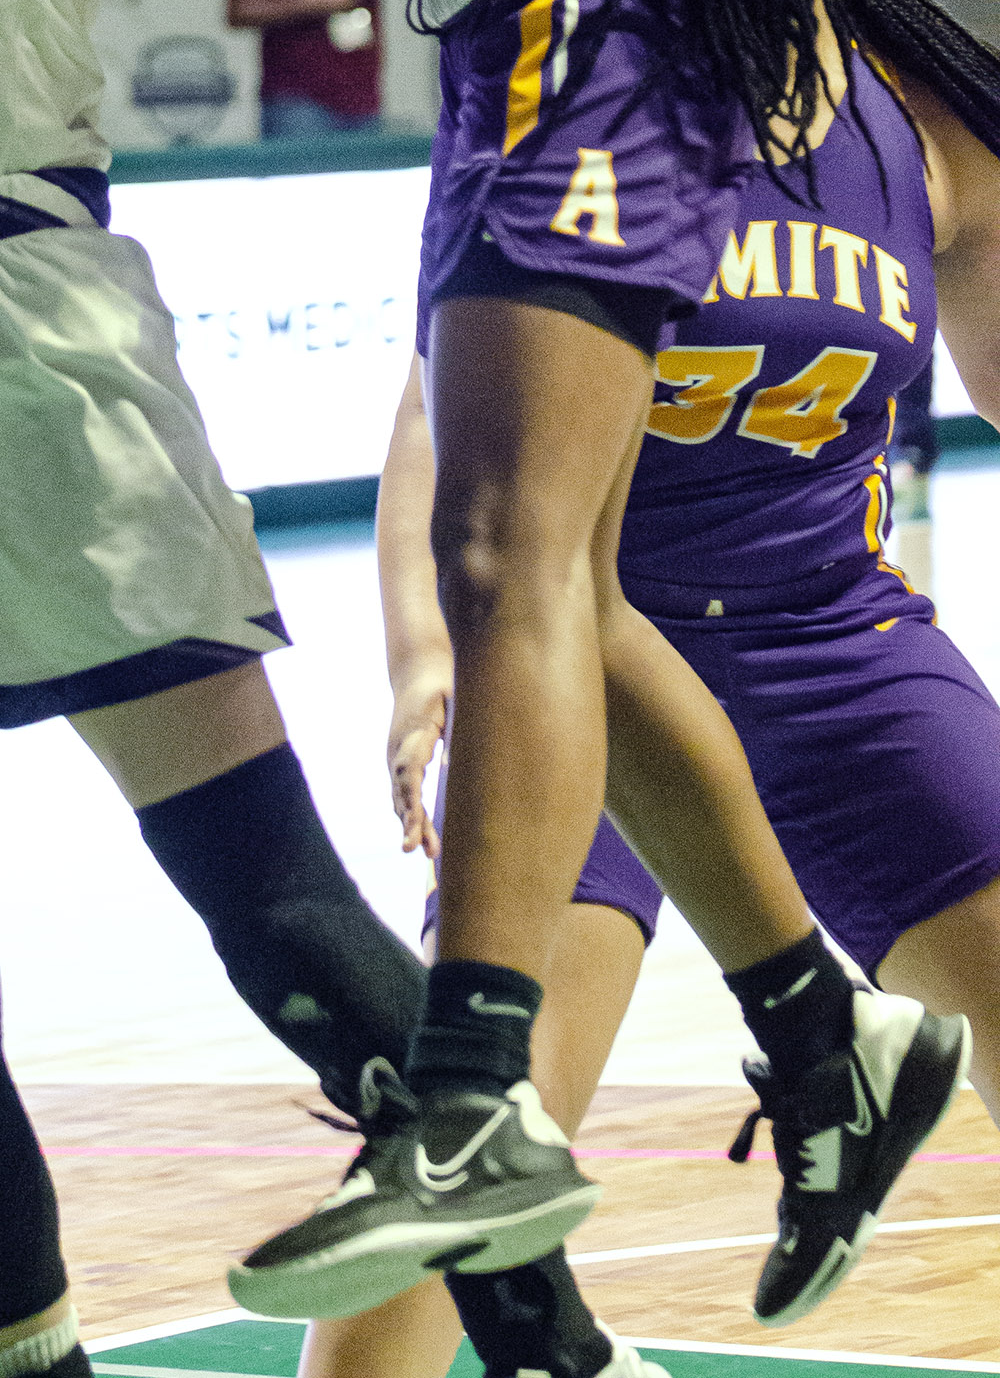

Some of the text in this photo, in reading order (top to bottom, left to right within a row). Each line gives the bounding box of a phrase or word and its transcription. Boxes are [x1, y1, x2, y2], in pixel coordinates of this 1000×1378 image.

[550, 147, 627, 248] A
[703, 220, 918, 344] MITE
[645, 344, 879, 459] 34
